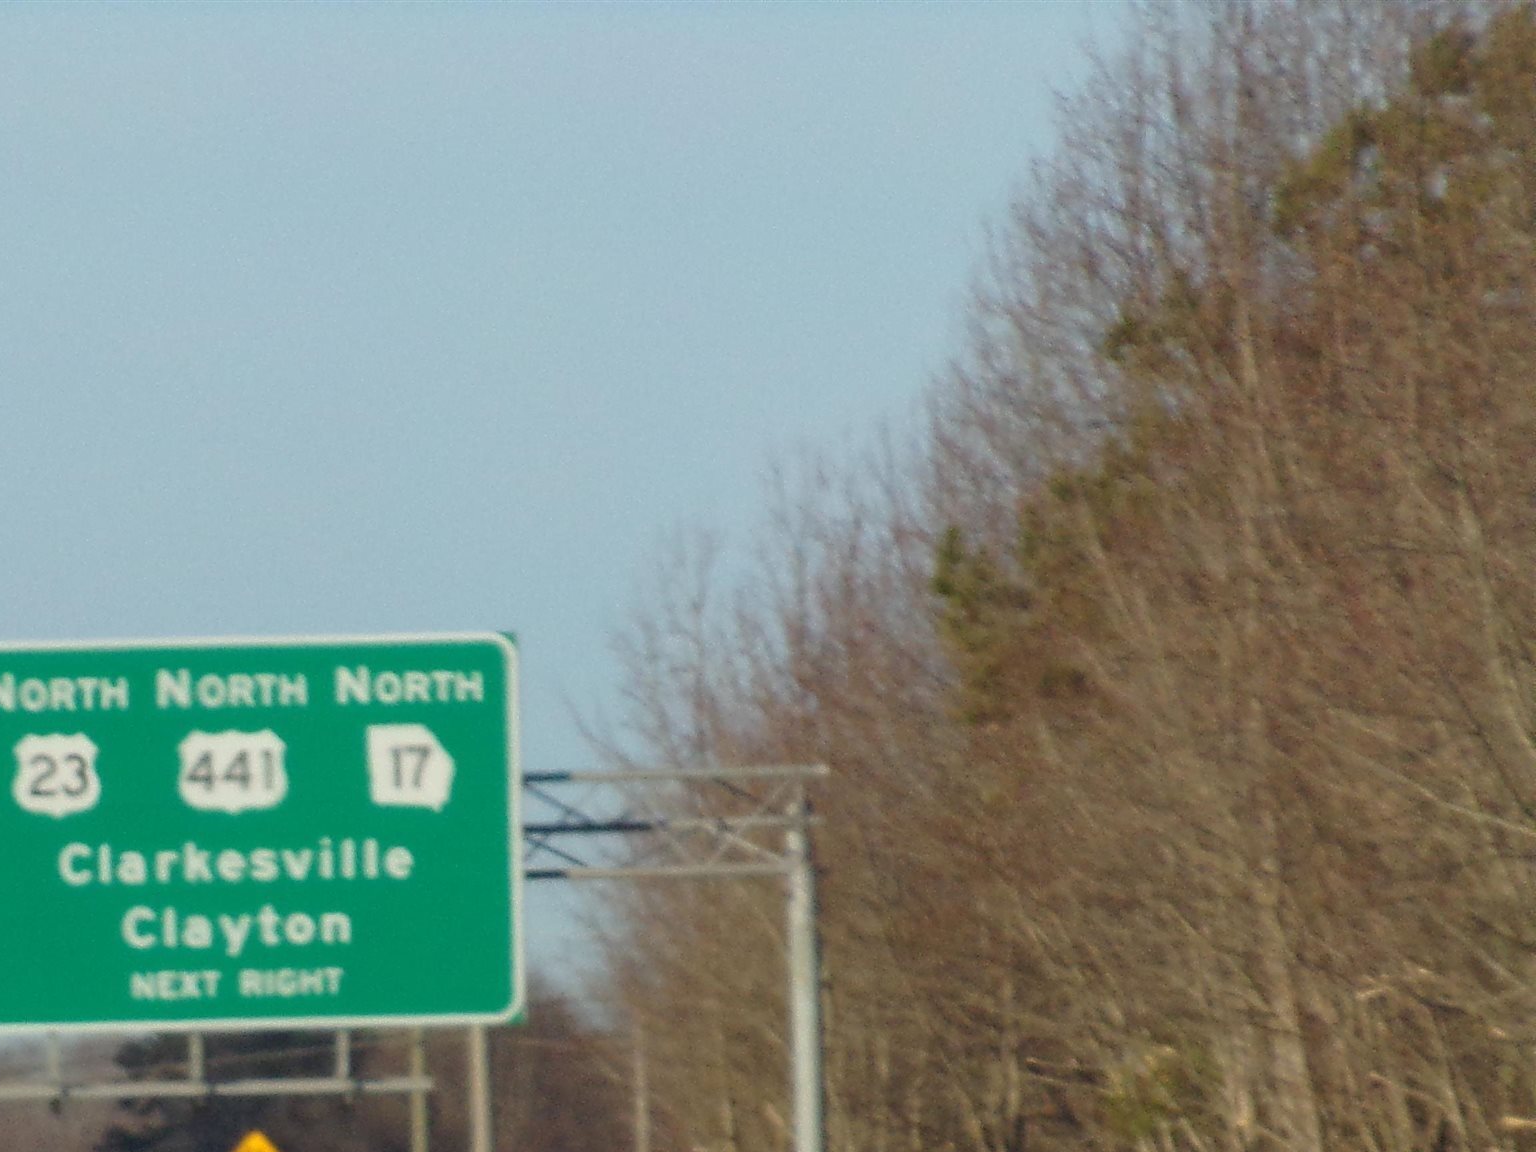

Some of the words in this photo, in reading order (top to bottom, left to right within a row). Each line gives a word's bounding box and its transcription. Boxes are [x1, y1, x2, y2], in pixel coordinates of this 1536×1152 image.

[155, 668, 308, 709] NORTH
[334, 665, 484, 705] NORTH
[28, 753, 91, 797] 23
[186, 748, 274, 792] 441
[389, 745, 432, 789] 17
[57, 838, 414, 886] Clarkesville
[121, 905, 352, 957] Clayton
[130, 970, 221, 1000] NEXT
[239, 967, 344, 997] RIGHT
